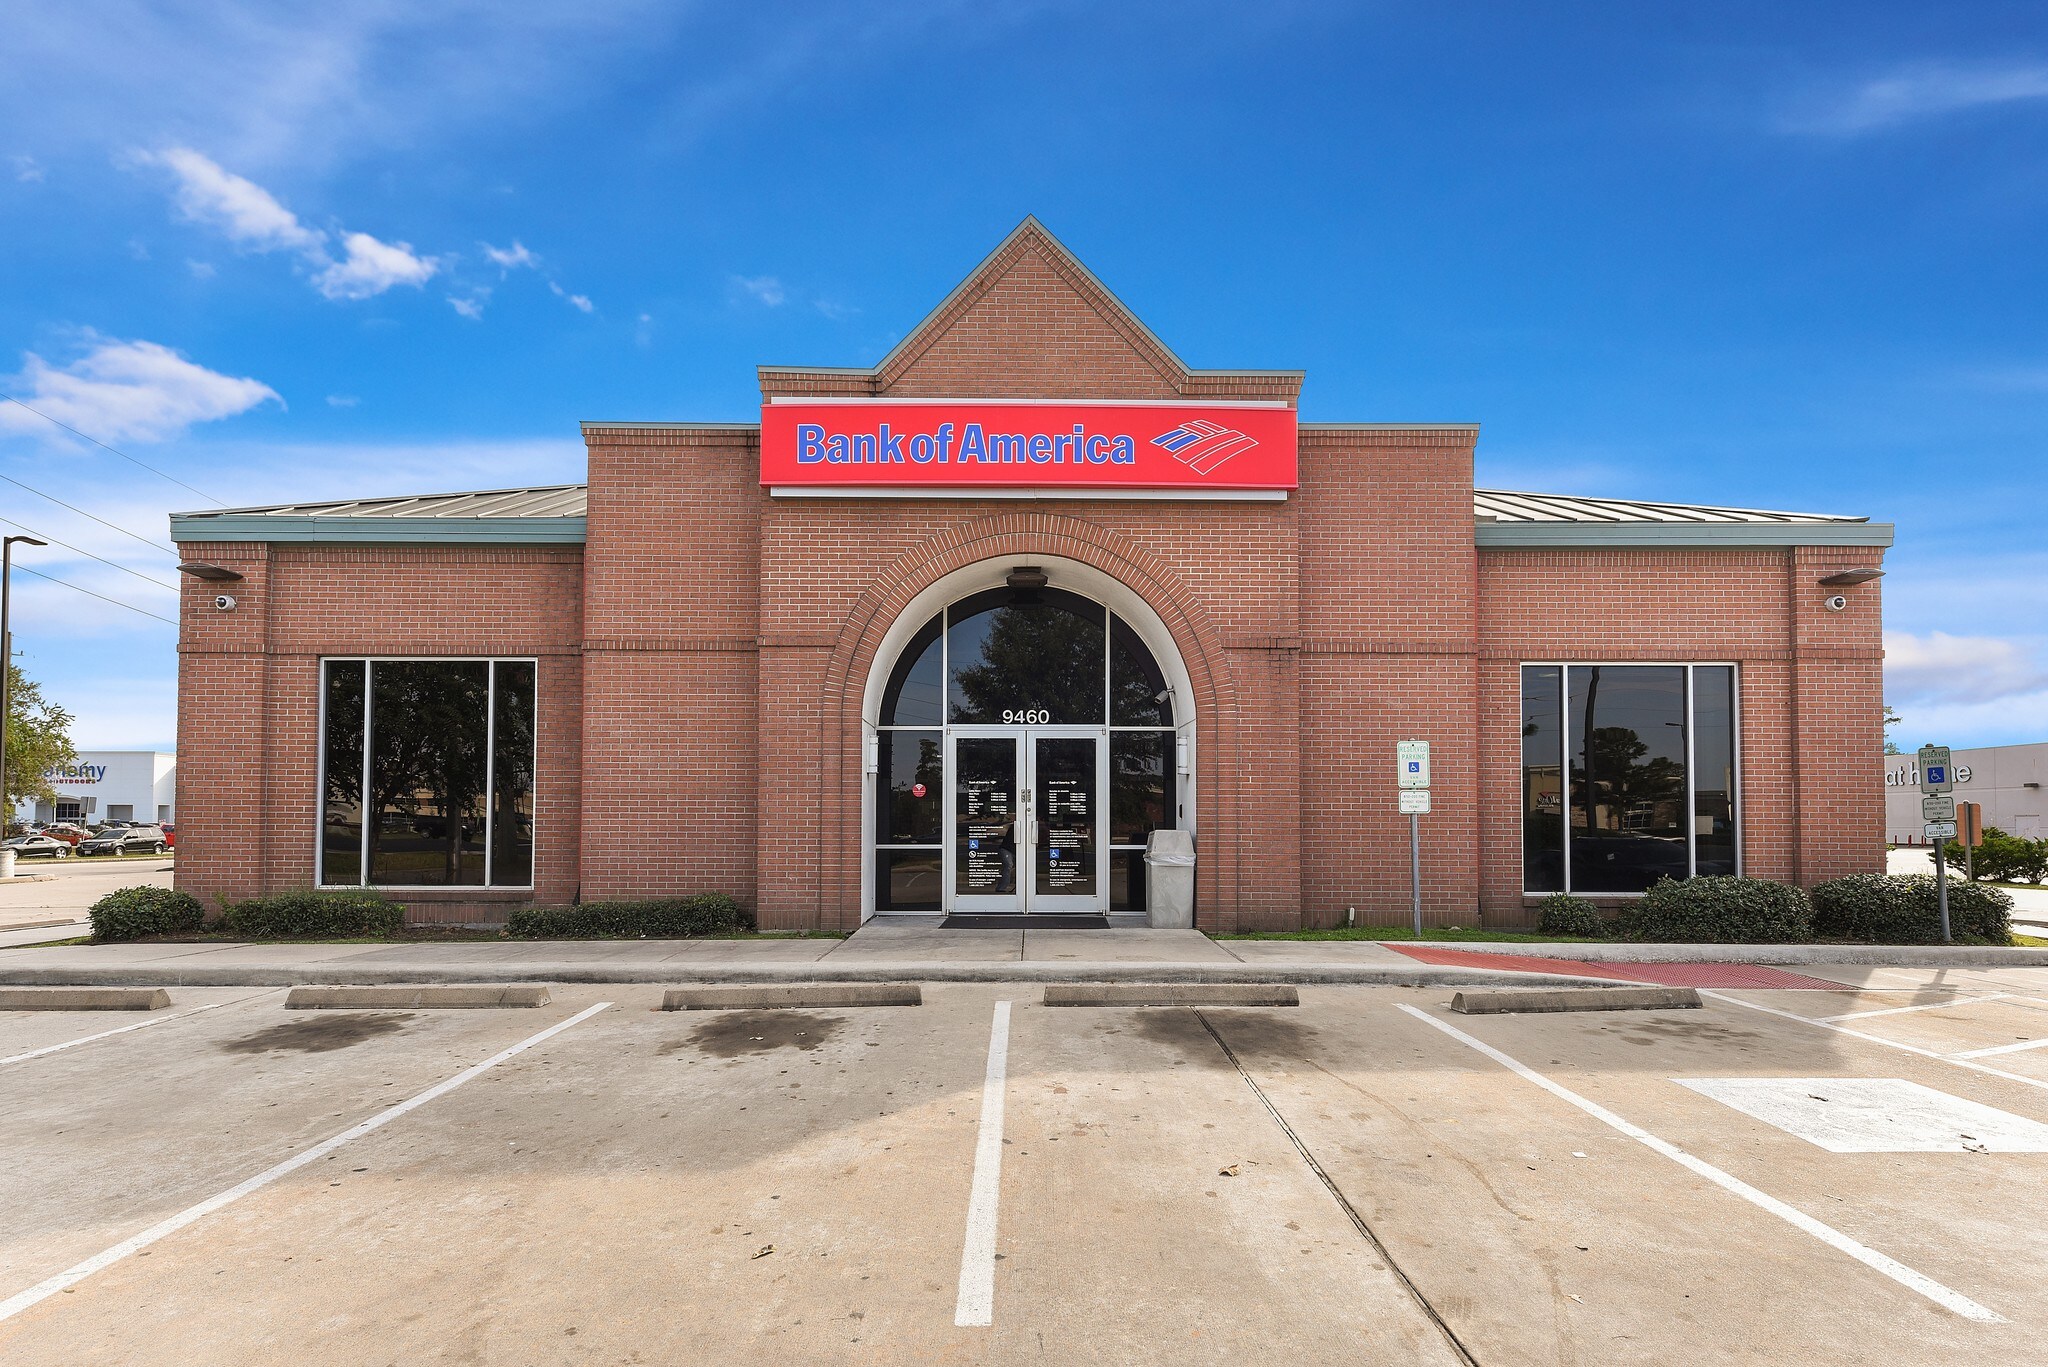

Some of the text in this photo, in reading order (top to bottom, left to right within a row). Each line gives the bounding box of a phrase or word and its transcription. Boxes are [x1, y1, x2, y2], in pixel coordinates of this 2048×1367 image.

[797, 423, 1136, 464] Bank of America
[1002, 709, 1050, 724] 9460
[1920, 750, 1949, 758] RESERVED
[1886, 761, 1972, 787] at he
